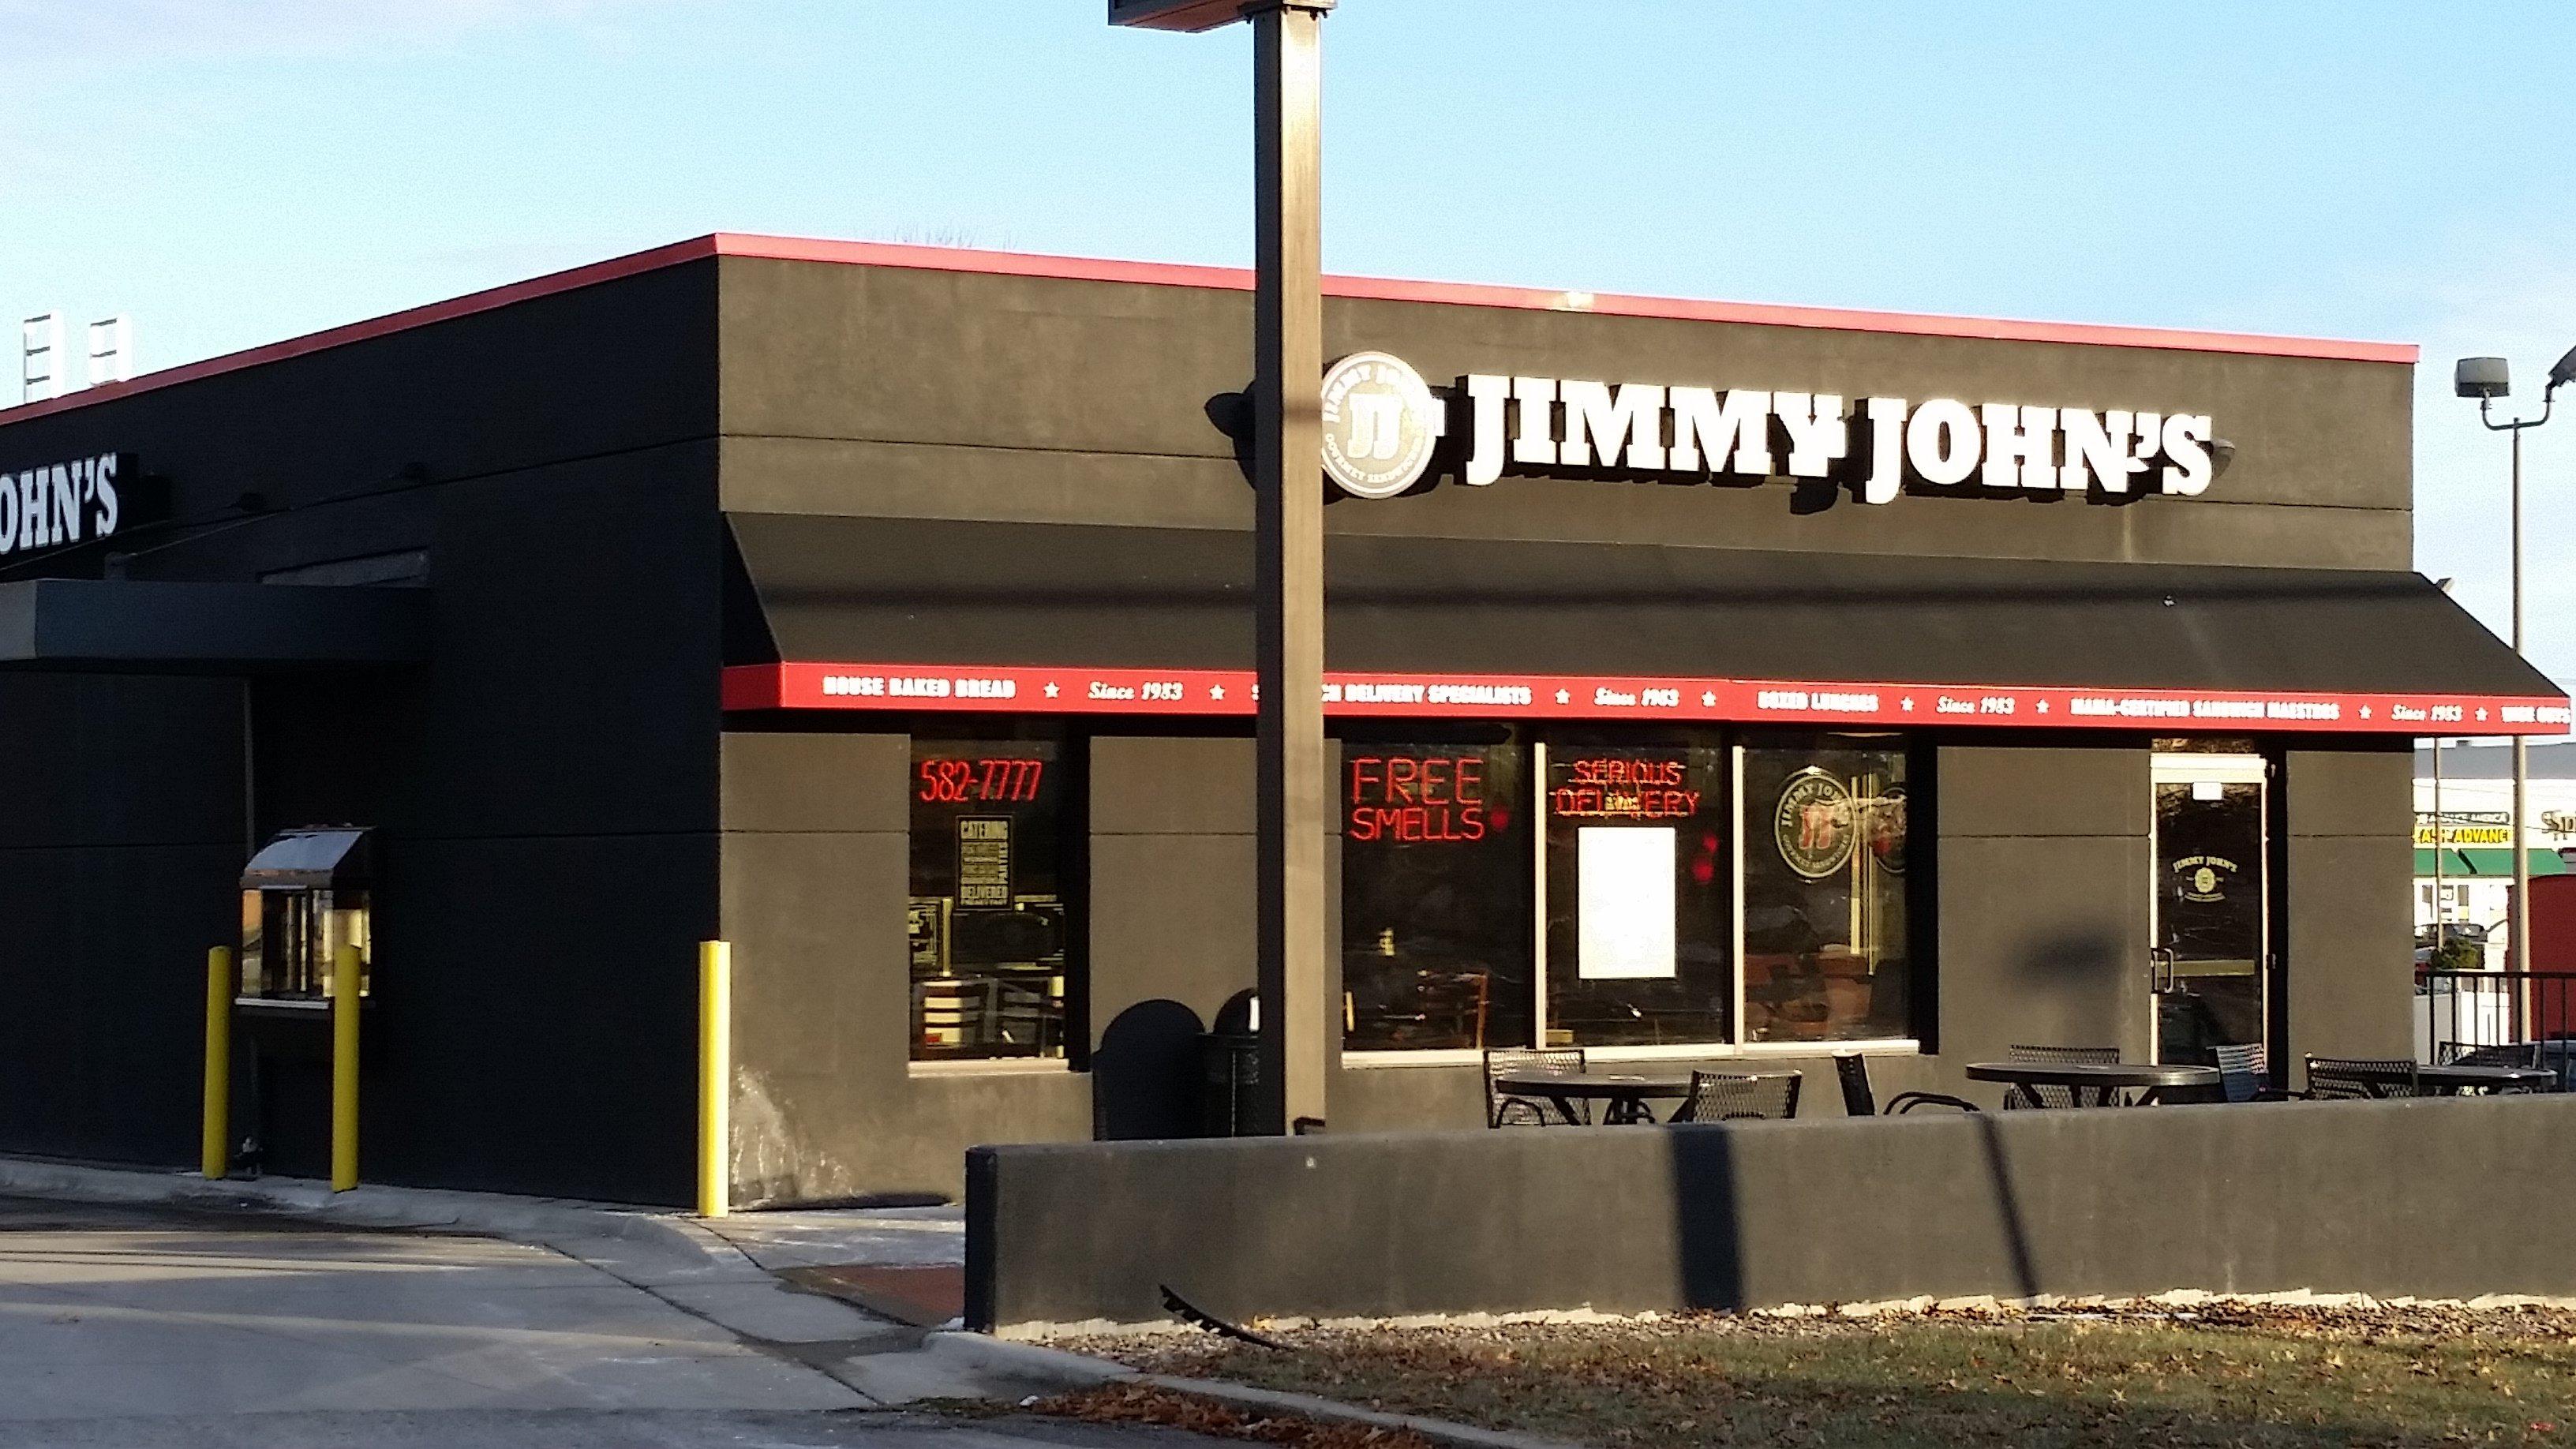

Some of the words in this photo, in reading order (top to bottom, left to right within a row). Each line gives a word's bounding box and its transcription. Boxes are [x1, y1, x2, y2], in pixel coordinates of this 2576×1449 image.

[1466, 374, 1847, 486] JIMMY
[1865, 396, 2212, 504] JOHN'S
[822, 676, 885, 696] HOUSE
[889, 677, 950, 698] BAKED
[954, 679, 1016, 698] BREAD
[1088, 681, 1135, 700] Since
[1141, 682, 1183, 700] 1983
[1344, 683, 1425, 703] DELIVERY
[1935, 695, 1975, 714] Since
[1980, 697, 2015, 714] 1983
[919, 758, 1043, 803] 582-7777
[1352, 755, 1484, 805] FREE
[1572, 758, 1682, 786] SERIOUS
[1349, 806, 1485, 842] SMELLS
[2453, 829, 2510, 844] ADVANC
